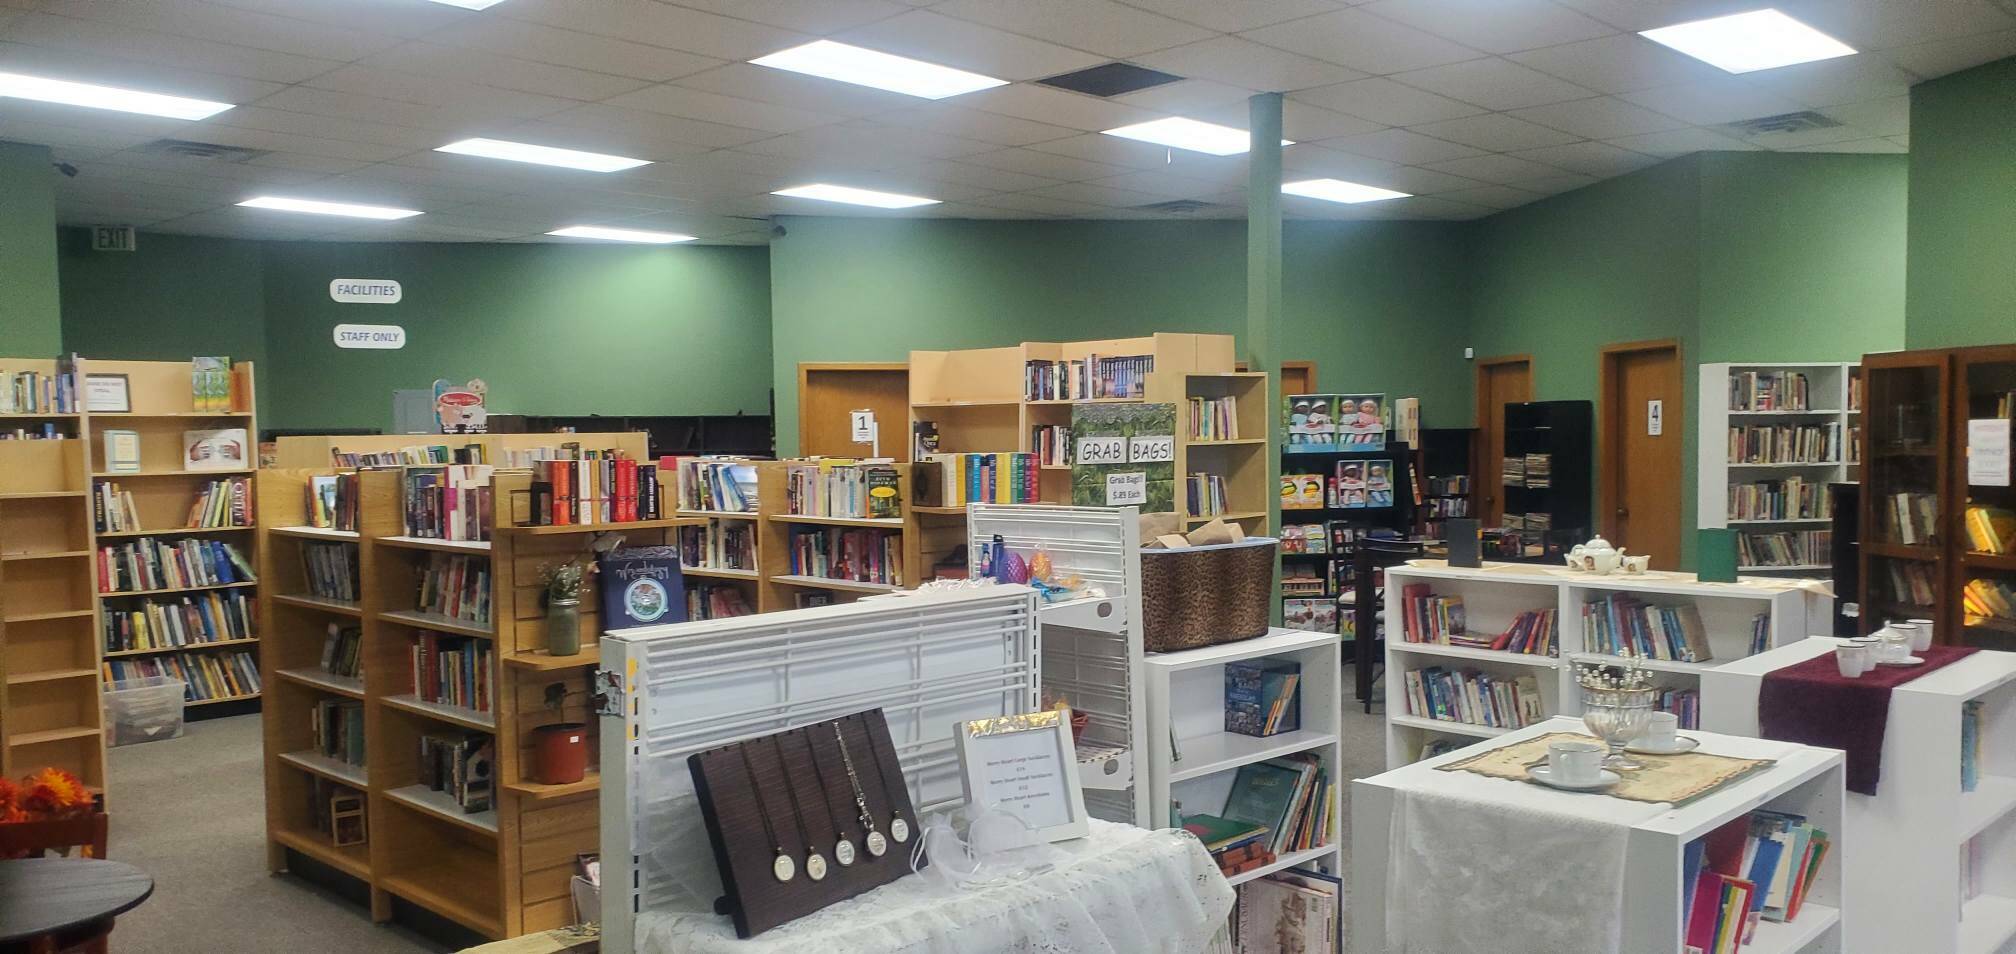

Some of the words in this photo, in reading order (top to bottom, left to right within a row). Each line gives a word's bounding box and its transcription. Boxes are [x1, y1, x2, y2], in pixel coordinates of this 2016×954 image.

[98, 228, 128, 249] EXIT
[337, 284, 396, 297] FACILITIES
[340, 331, 370, 342] STAFF
[372, 332, 400, 342] ONLY
[1652, 404, 1659, 423] 4
[858, 415, 869, 431] 1
[1082, 442, 1121, 461] GRAB
[1133, 442, 1172, 460] BAGS!
